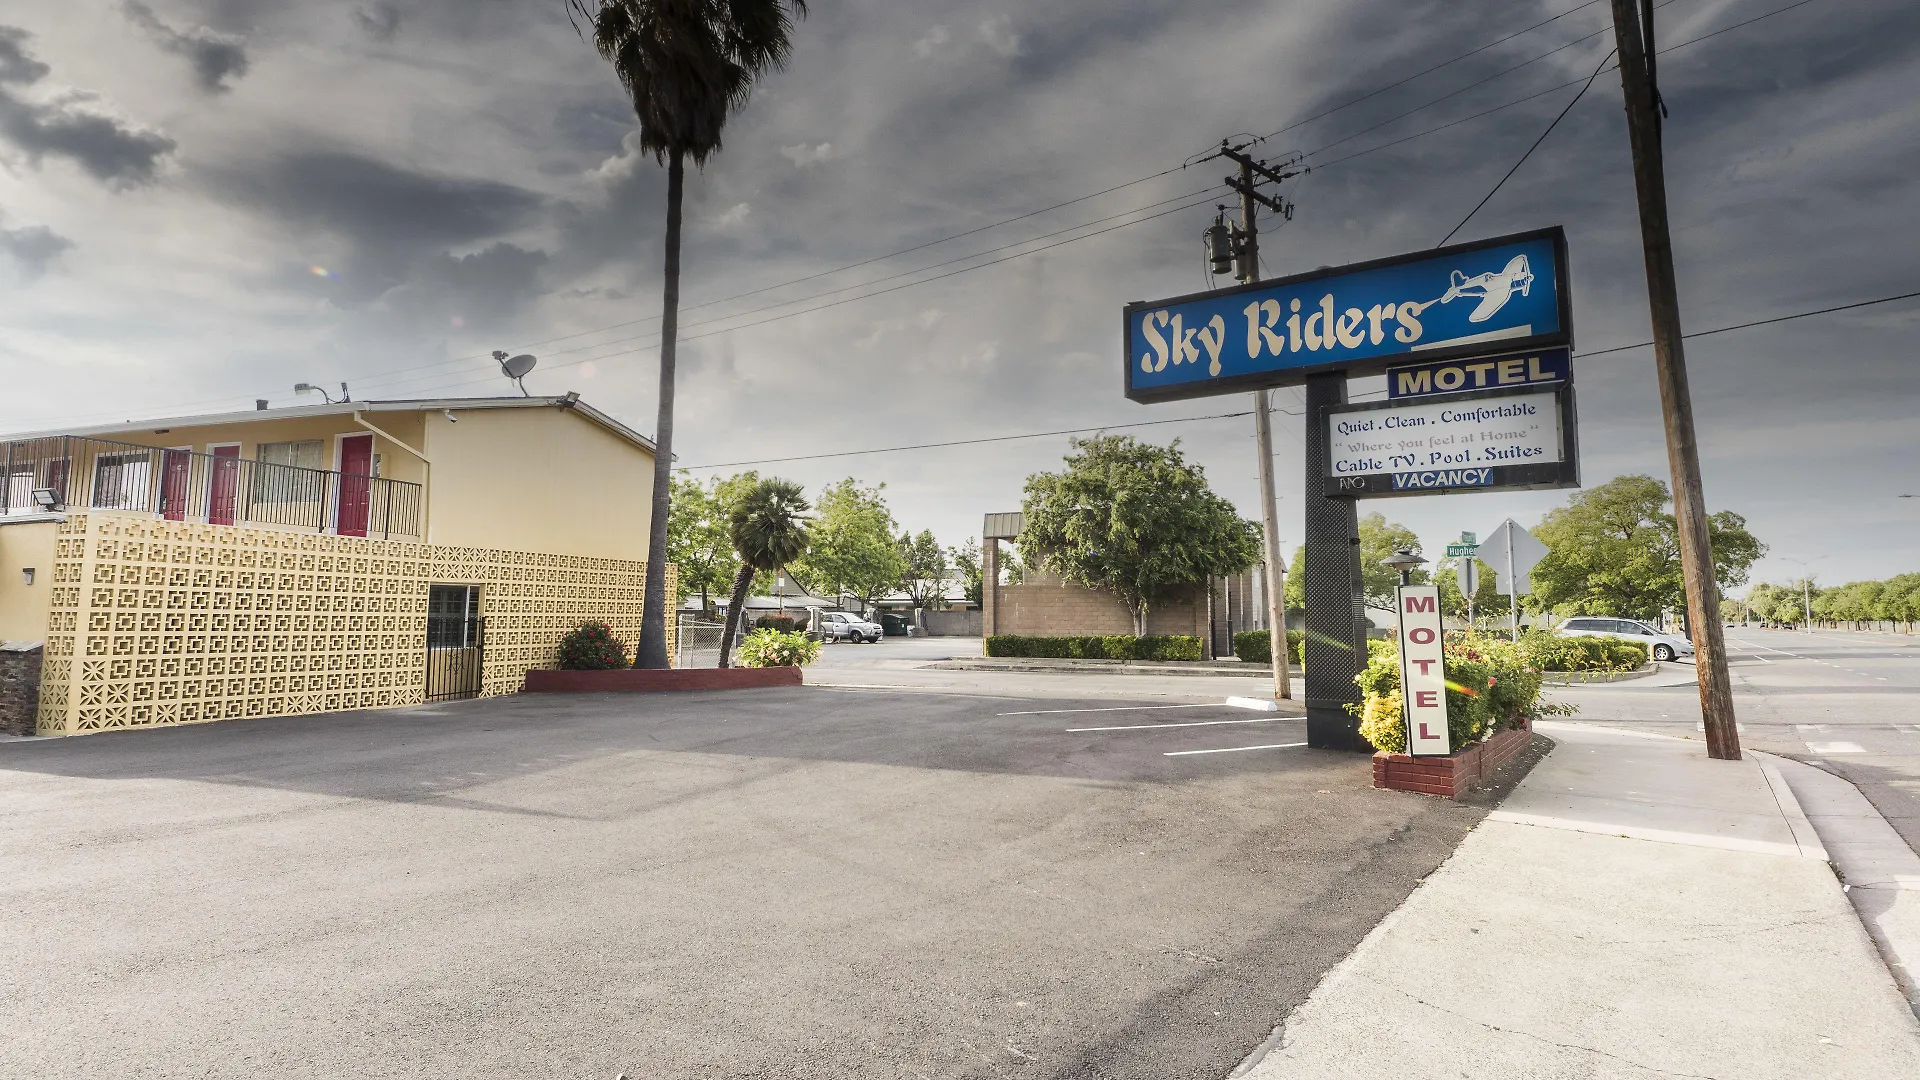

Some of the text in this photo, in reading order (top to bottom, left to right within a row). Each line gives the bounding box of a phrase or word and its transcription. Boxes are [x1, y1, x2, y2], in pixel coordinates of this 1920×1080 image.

[1141, 293, 1424, 377] Sky Riders
[1398, 357, 1556, 396] MOTEL
[1440, 402, 1537, 424] Comfortable
[1398, 440, 1424, 451] you
[1429, 435, 1455, 449] feel
[1460, 433, 1474, 443] at
[1335, 457, 1383, 473] Cable
[1484, 445, 1543, 461] Suites
[1395, 468, 1490, 488] VACANCY
[1405, 596, 1441, 740] MOTEL
